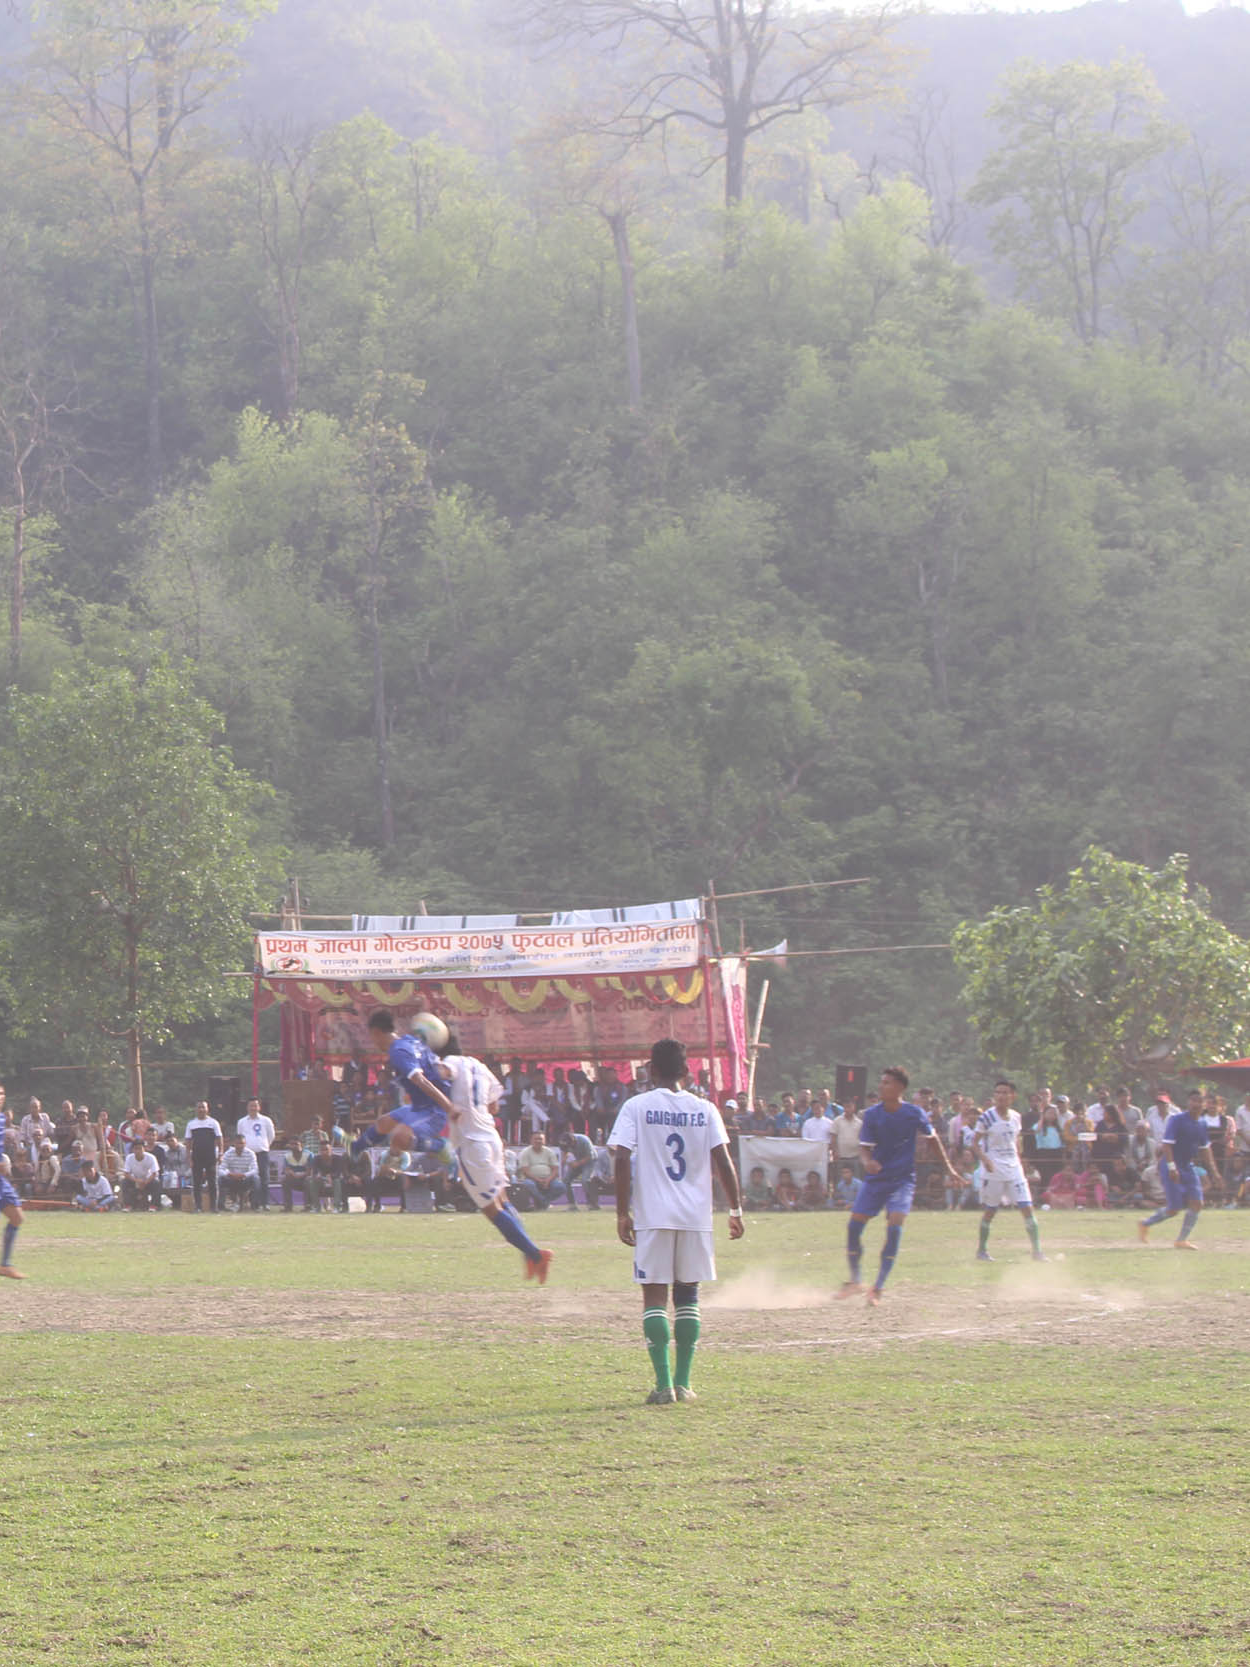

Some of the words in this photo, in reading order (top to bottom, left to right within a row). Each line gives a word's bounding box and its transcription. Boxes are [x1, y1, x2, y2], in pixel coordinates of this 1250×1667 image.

[266, 938, 307, 955] प्रथम
[314, 938, 367, 954] जाल्पा
[374, 933, 452, 952] गोल्डकप
[458, 934, 504, 950] २०७५
[582, 924, 696, 948] प्रतियोगितामा
[646, 1110, 688, 1127] GAIGHAT
[666, 1133, 687, 1182] 3
